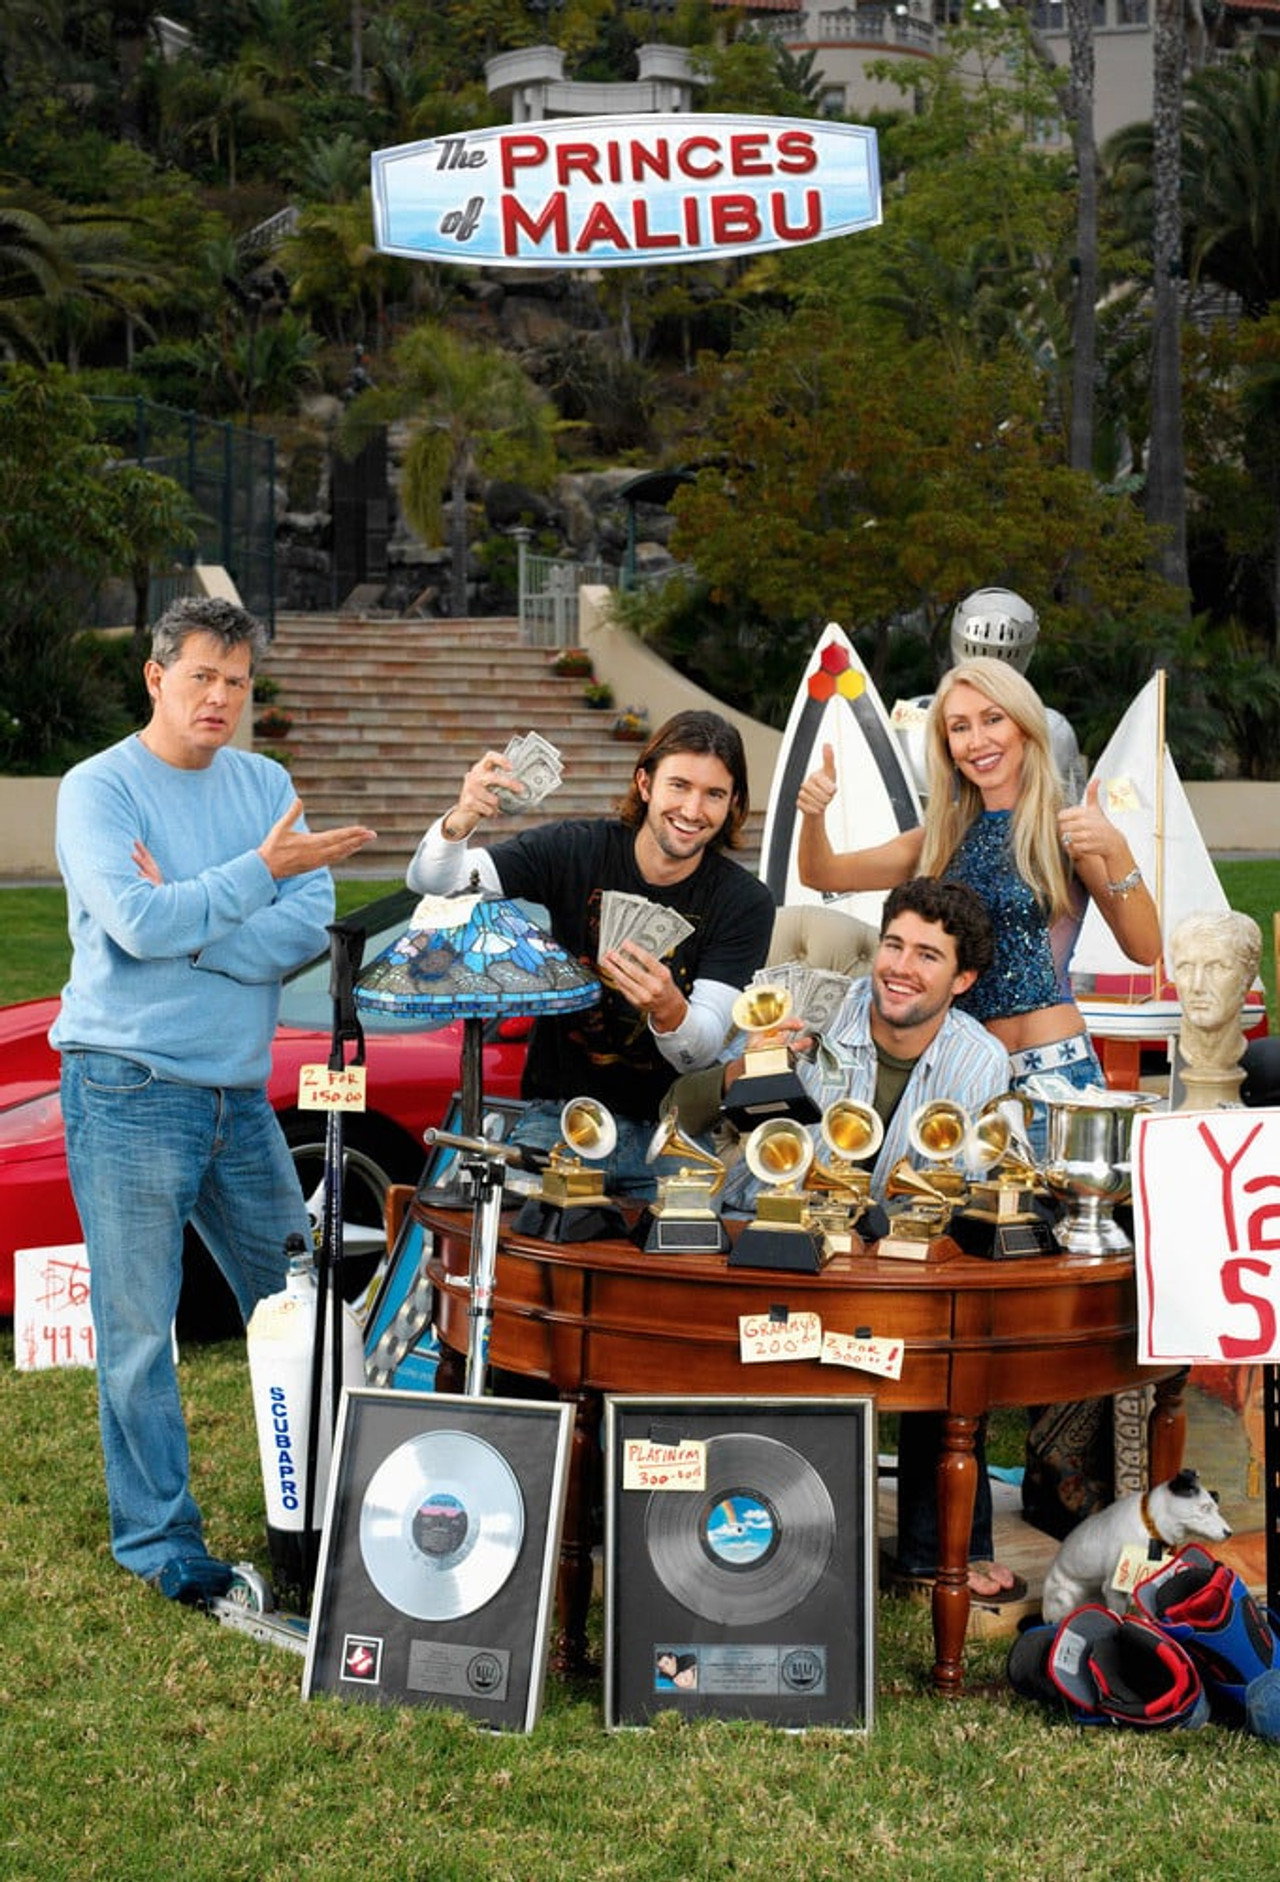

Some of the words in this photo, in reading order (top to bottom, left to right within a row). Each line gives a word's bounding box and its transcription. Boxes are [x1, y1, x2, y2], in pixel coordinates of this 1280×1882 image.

[303, 1069, 318, 1086] 2
[328, 1072, 358, 1085] FOR
[270, 1387, 298, 1510] SCUBAPRO
